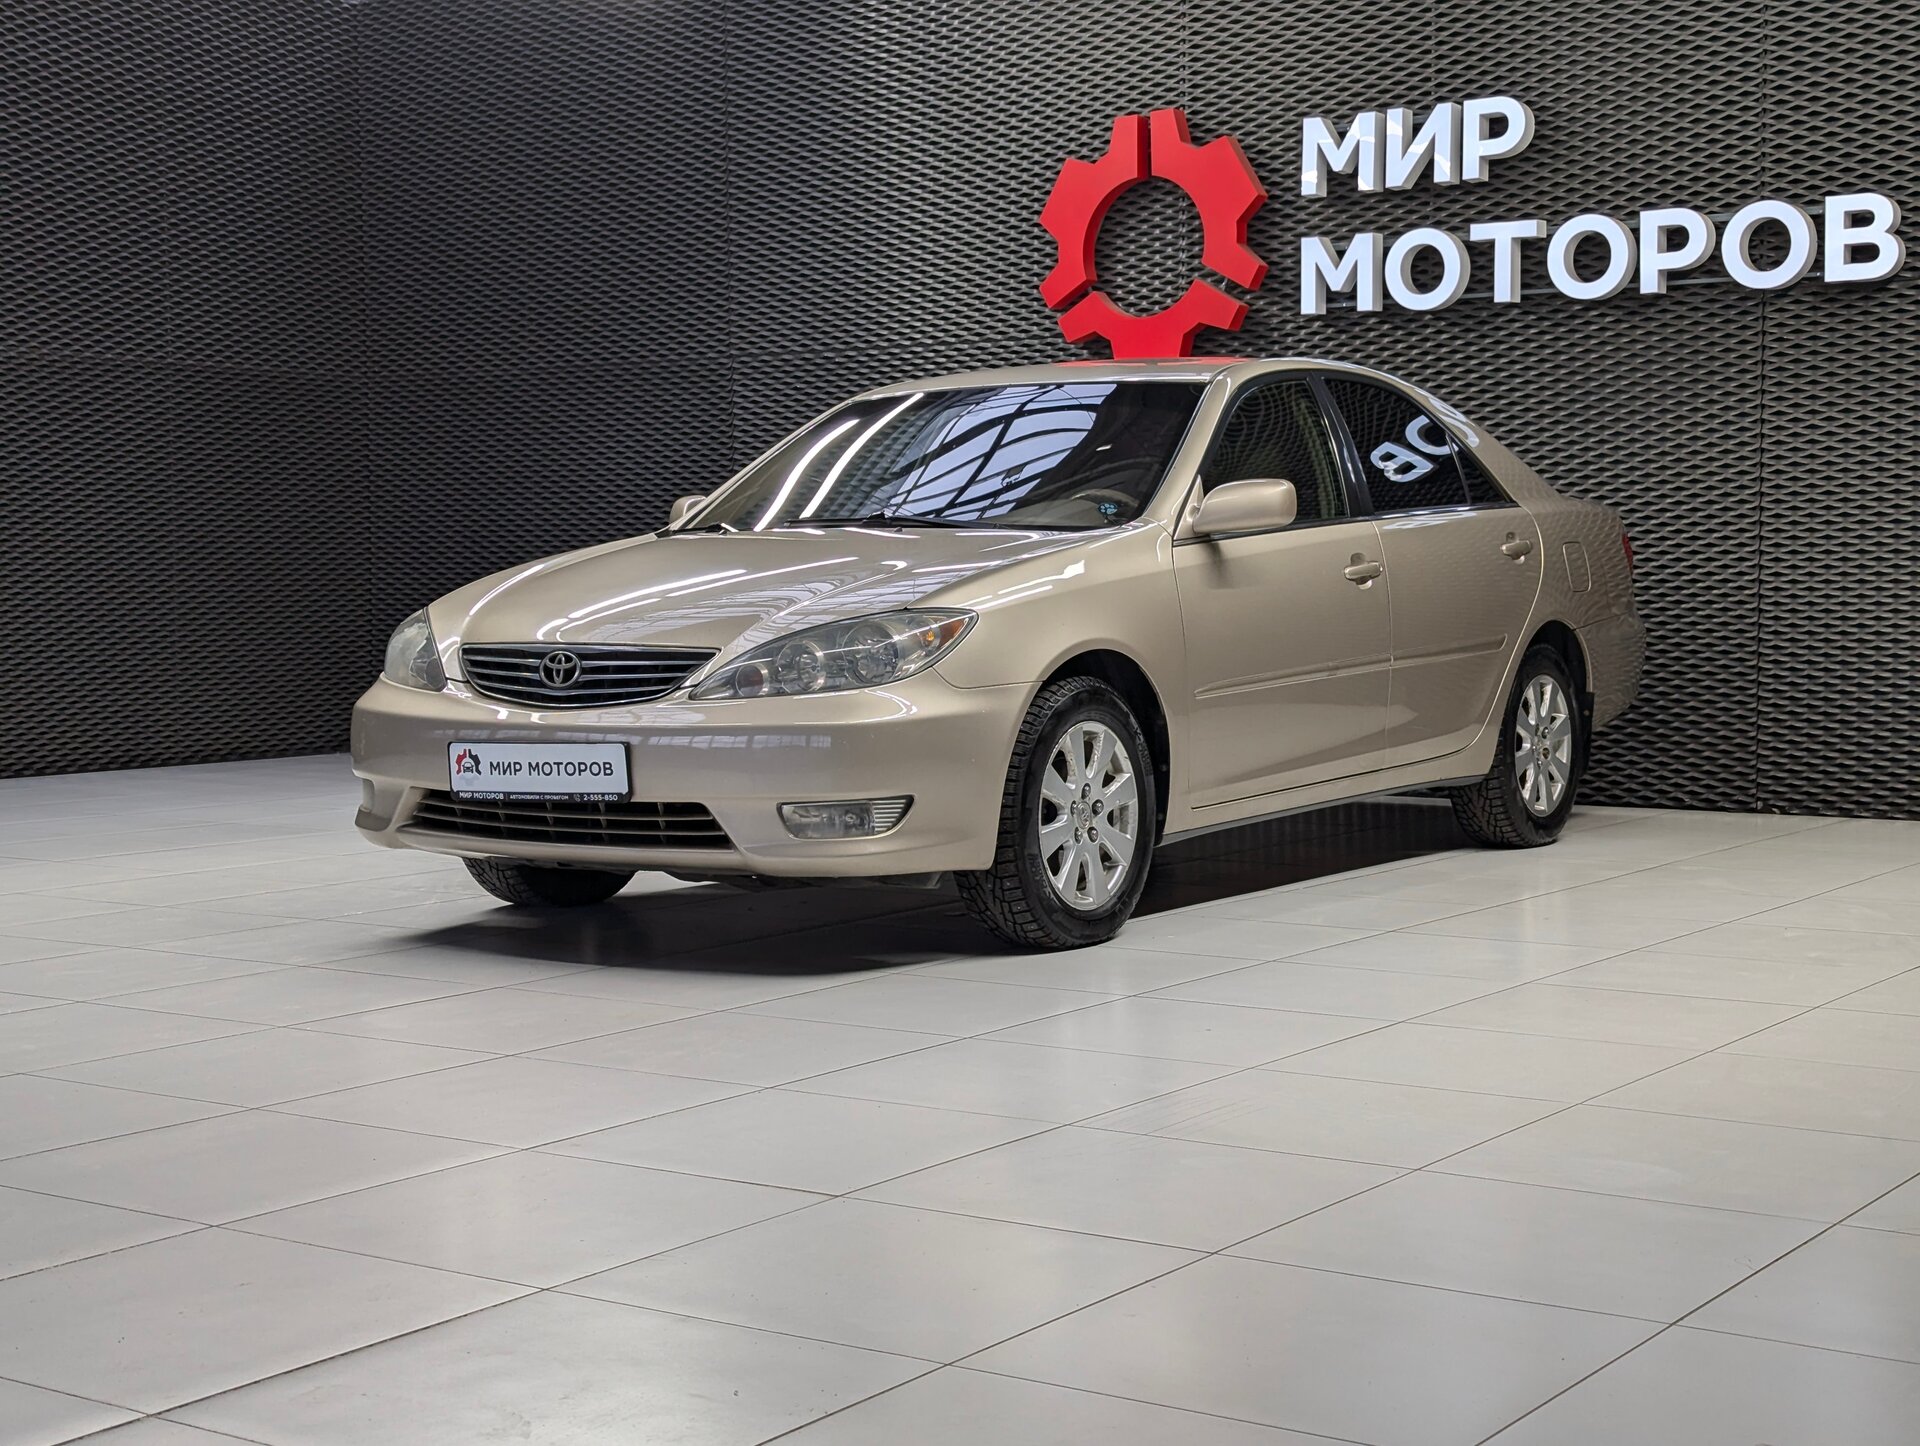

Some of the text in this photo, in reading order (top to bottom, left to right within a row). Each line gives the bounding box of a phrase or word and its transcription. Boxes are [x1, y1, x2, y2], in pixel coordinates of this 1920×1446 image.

[1300, 95, 1535, 198] МИР
[1299, 192, 1906, 316] МОТОРОВ
[473, 792, 504, 800] МОТОРОВ
[489, 761, 614, 777] МИР МОТОРОВ
